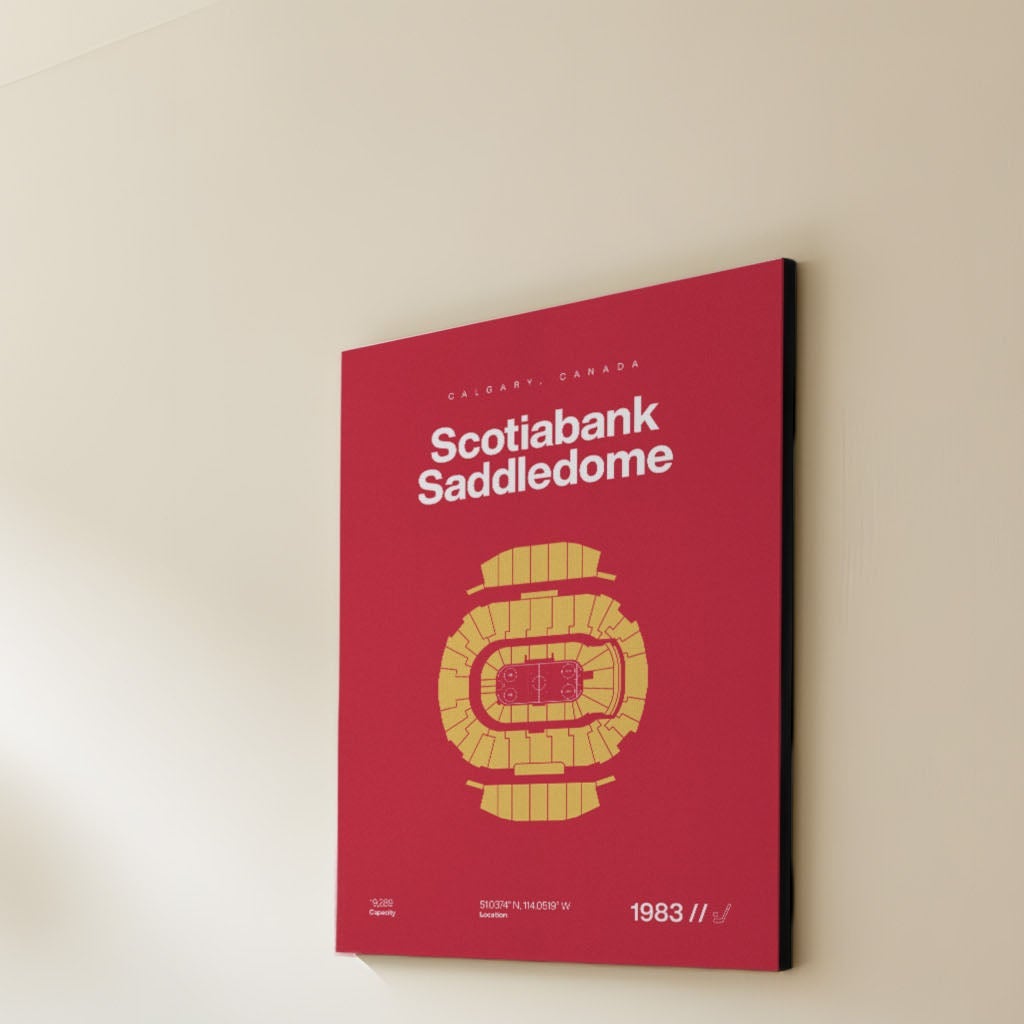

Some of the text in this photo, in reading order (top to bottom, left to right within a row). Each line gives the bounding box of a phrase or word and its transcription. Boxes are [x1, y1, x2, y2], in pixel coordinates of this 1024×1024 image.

[559, 359, 639, 381] CANADA
[431, 395, 660, 464] Scotiabank
[418, 444, 674, 505] Saddledome
[561, 901, 571, 911] W
[630, 902, 684, 923] 1983
